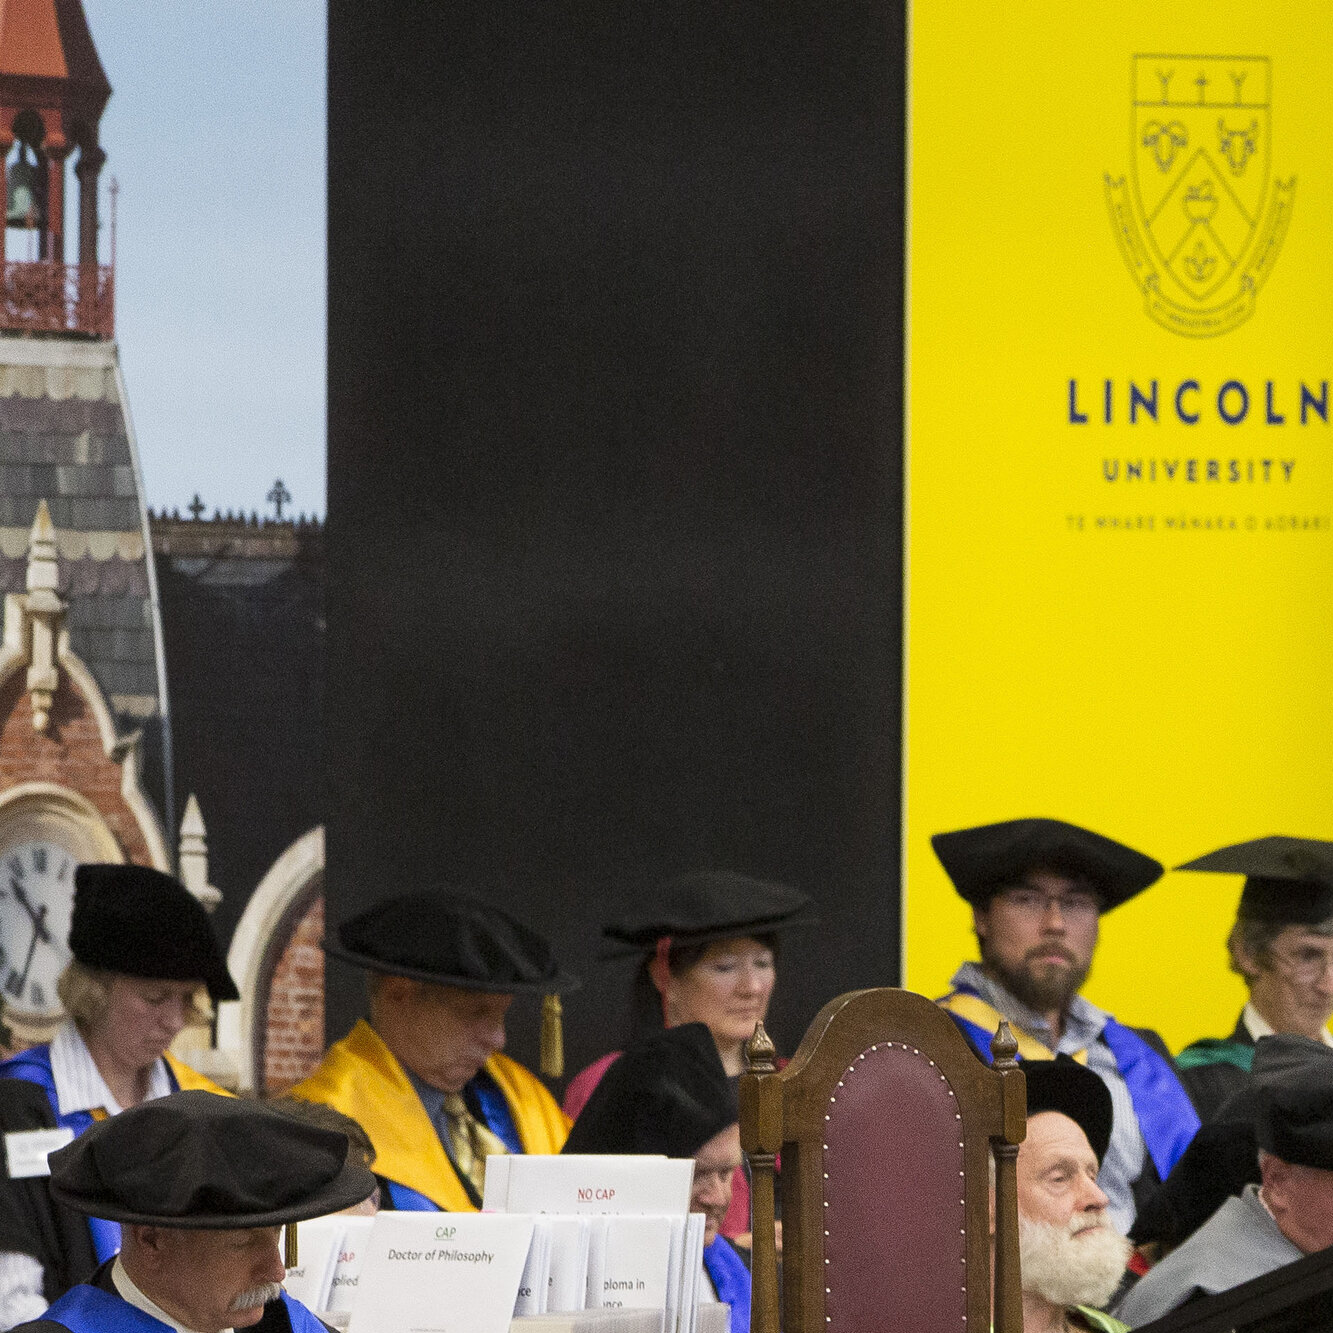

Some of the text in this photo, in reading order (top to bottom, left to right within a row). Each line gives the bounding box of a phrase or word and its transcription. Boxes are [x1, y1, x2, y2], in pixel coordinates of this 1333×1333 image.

[1067, 379, 1329, 425] LINCOLN
[1103, 458, 1295, 483] UNIVERSITY
[578, 1188, 616, 1201] NO CAP
[435, 1227, 457, 1239] CAP
[388, 1249, 495, 1264] Doctor of Philosophy
[636, 1278, 645, 1290] in
